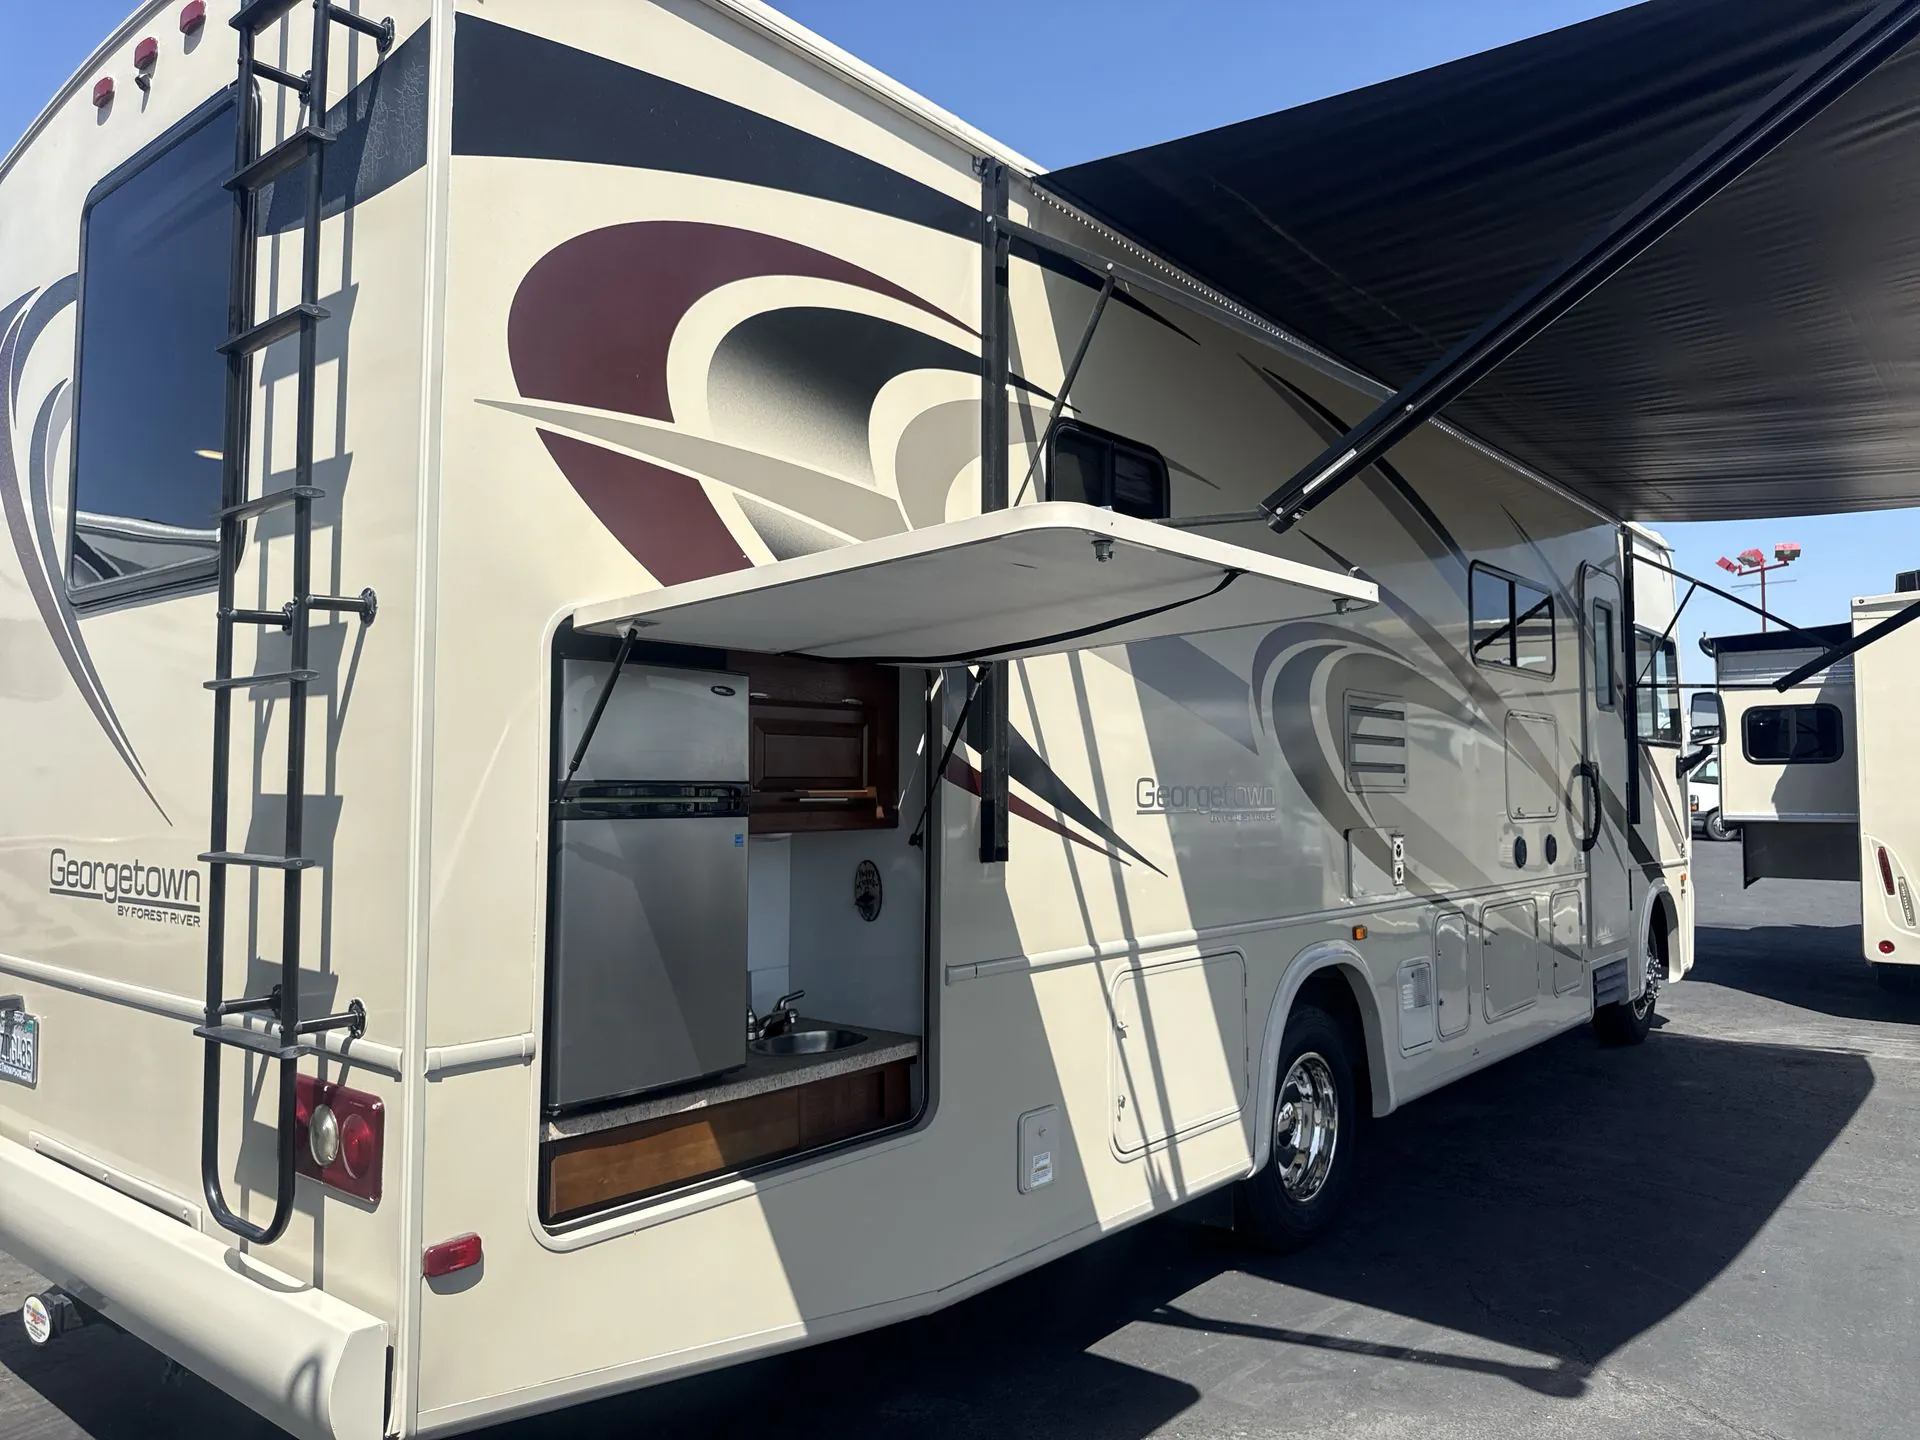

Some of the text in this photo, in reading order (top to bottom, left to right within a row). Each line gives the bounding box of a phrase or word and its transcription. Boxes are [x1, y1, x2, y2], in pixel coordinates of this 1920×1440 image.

[1136, 777, 1276, 813] Georgetown
[50, 848, 201, 903] Georgetown
[117, 905, 201, 927] BY FOREST RIVER
